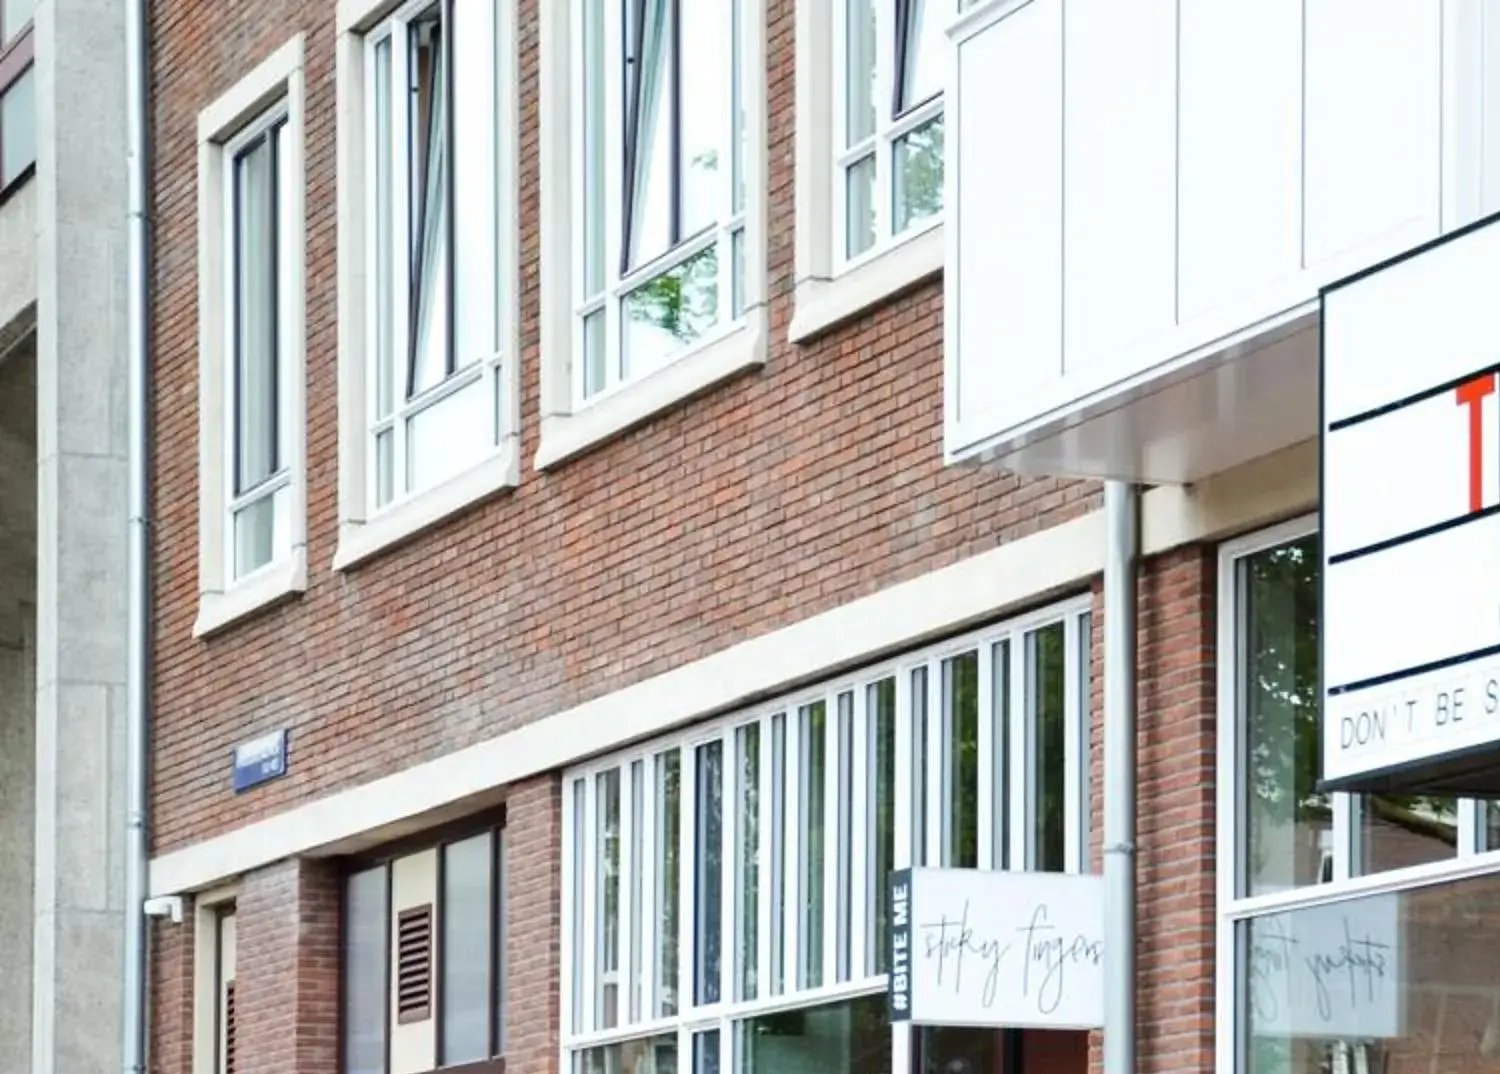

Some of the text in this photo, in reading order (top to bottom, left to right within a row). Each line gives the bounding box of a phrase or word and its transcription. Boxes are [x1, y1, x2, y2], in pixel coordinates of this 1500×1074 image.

[1341, 699, 1418, 750] DON'T
[1435, 687, 1466, 727] BE
[893, 883, 909, 1011] #BITE ME
[920, 898, 1013, 1009] sticky
